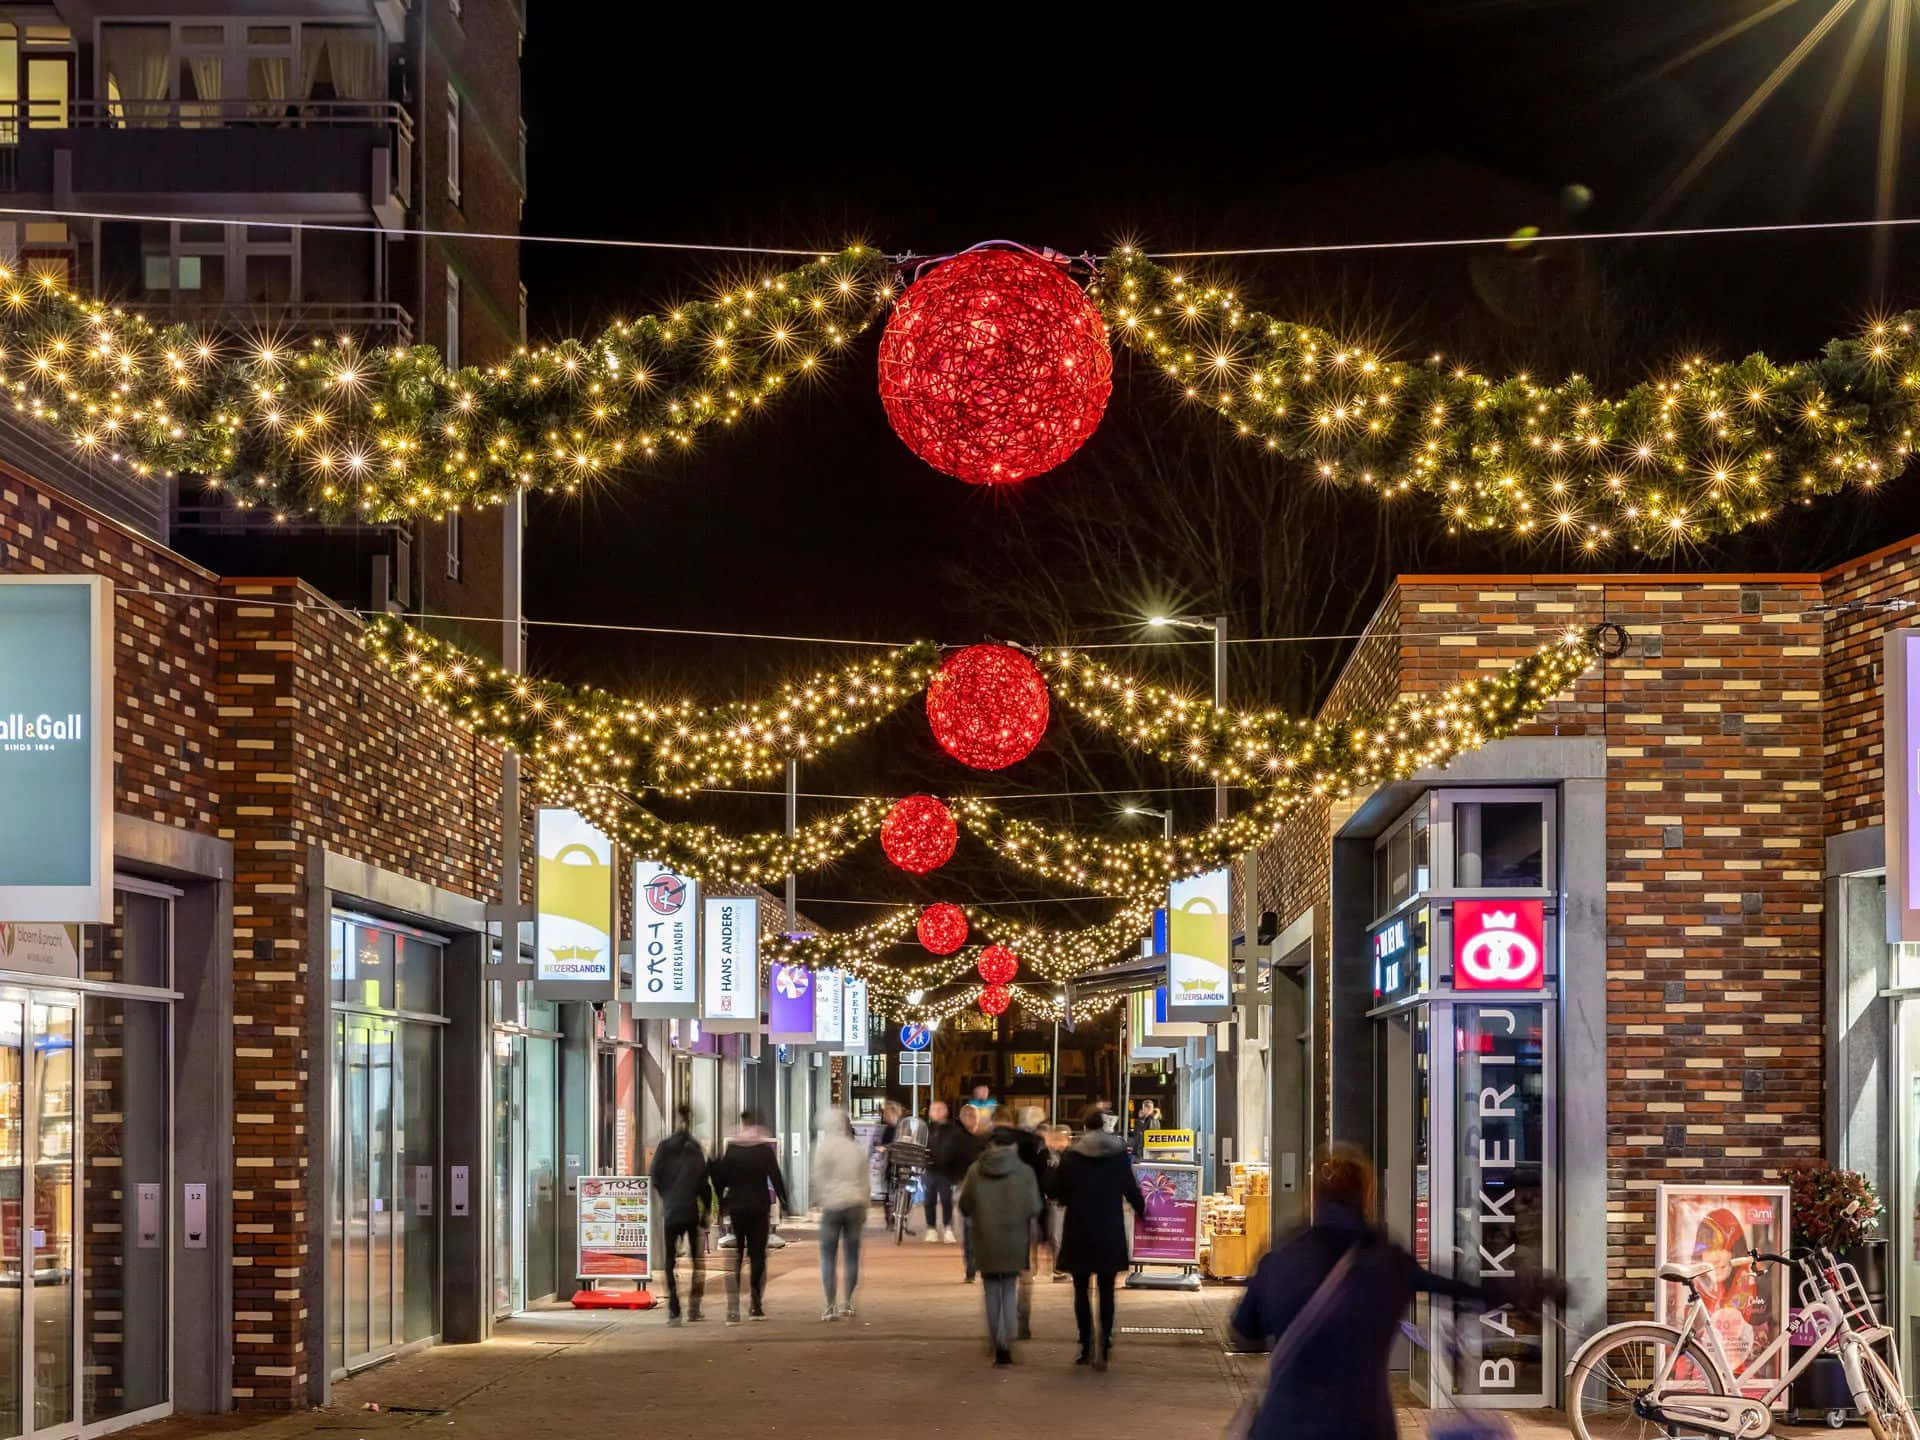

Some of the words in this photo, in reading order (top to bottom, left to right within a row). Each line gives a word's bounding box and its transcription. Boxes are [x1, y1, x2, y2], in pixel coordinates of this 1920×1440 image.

[0, 713, 82, 740] all&Gall
[4, 743, 32, 751] SINDS
[721, 906, 733, 954] ANDERS
[543, 964, 606, 973] KEIZERSLANDEN
[647, 921, 667, 993] TOKO
[673, 921, 684, 991] KEIZERSLANDEN
[721, 958, 733, 992] HANS
[851, 991, 860, 1040] PETERS
[1147, 1134, 1190, 1143] ZEEMAN
[605, 1180, 648, 1191] TOKO
[1479, 1008, 1516, 1389] BAKKERIJ
